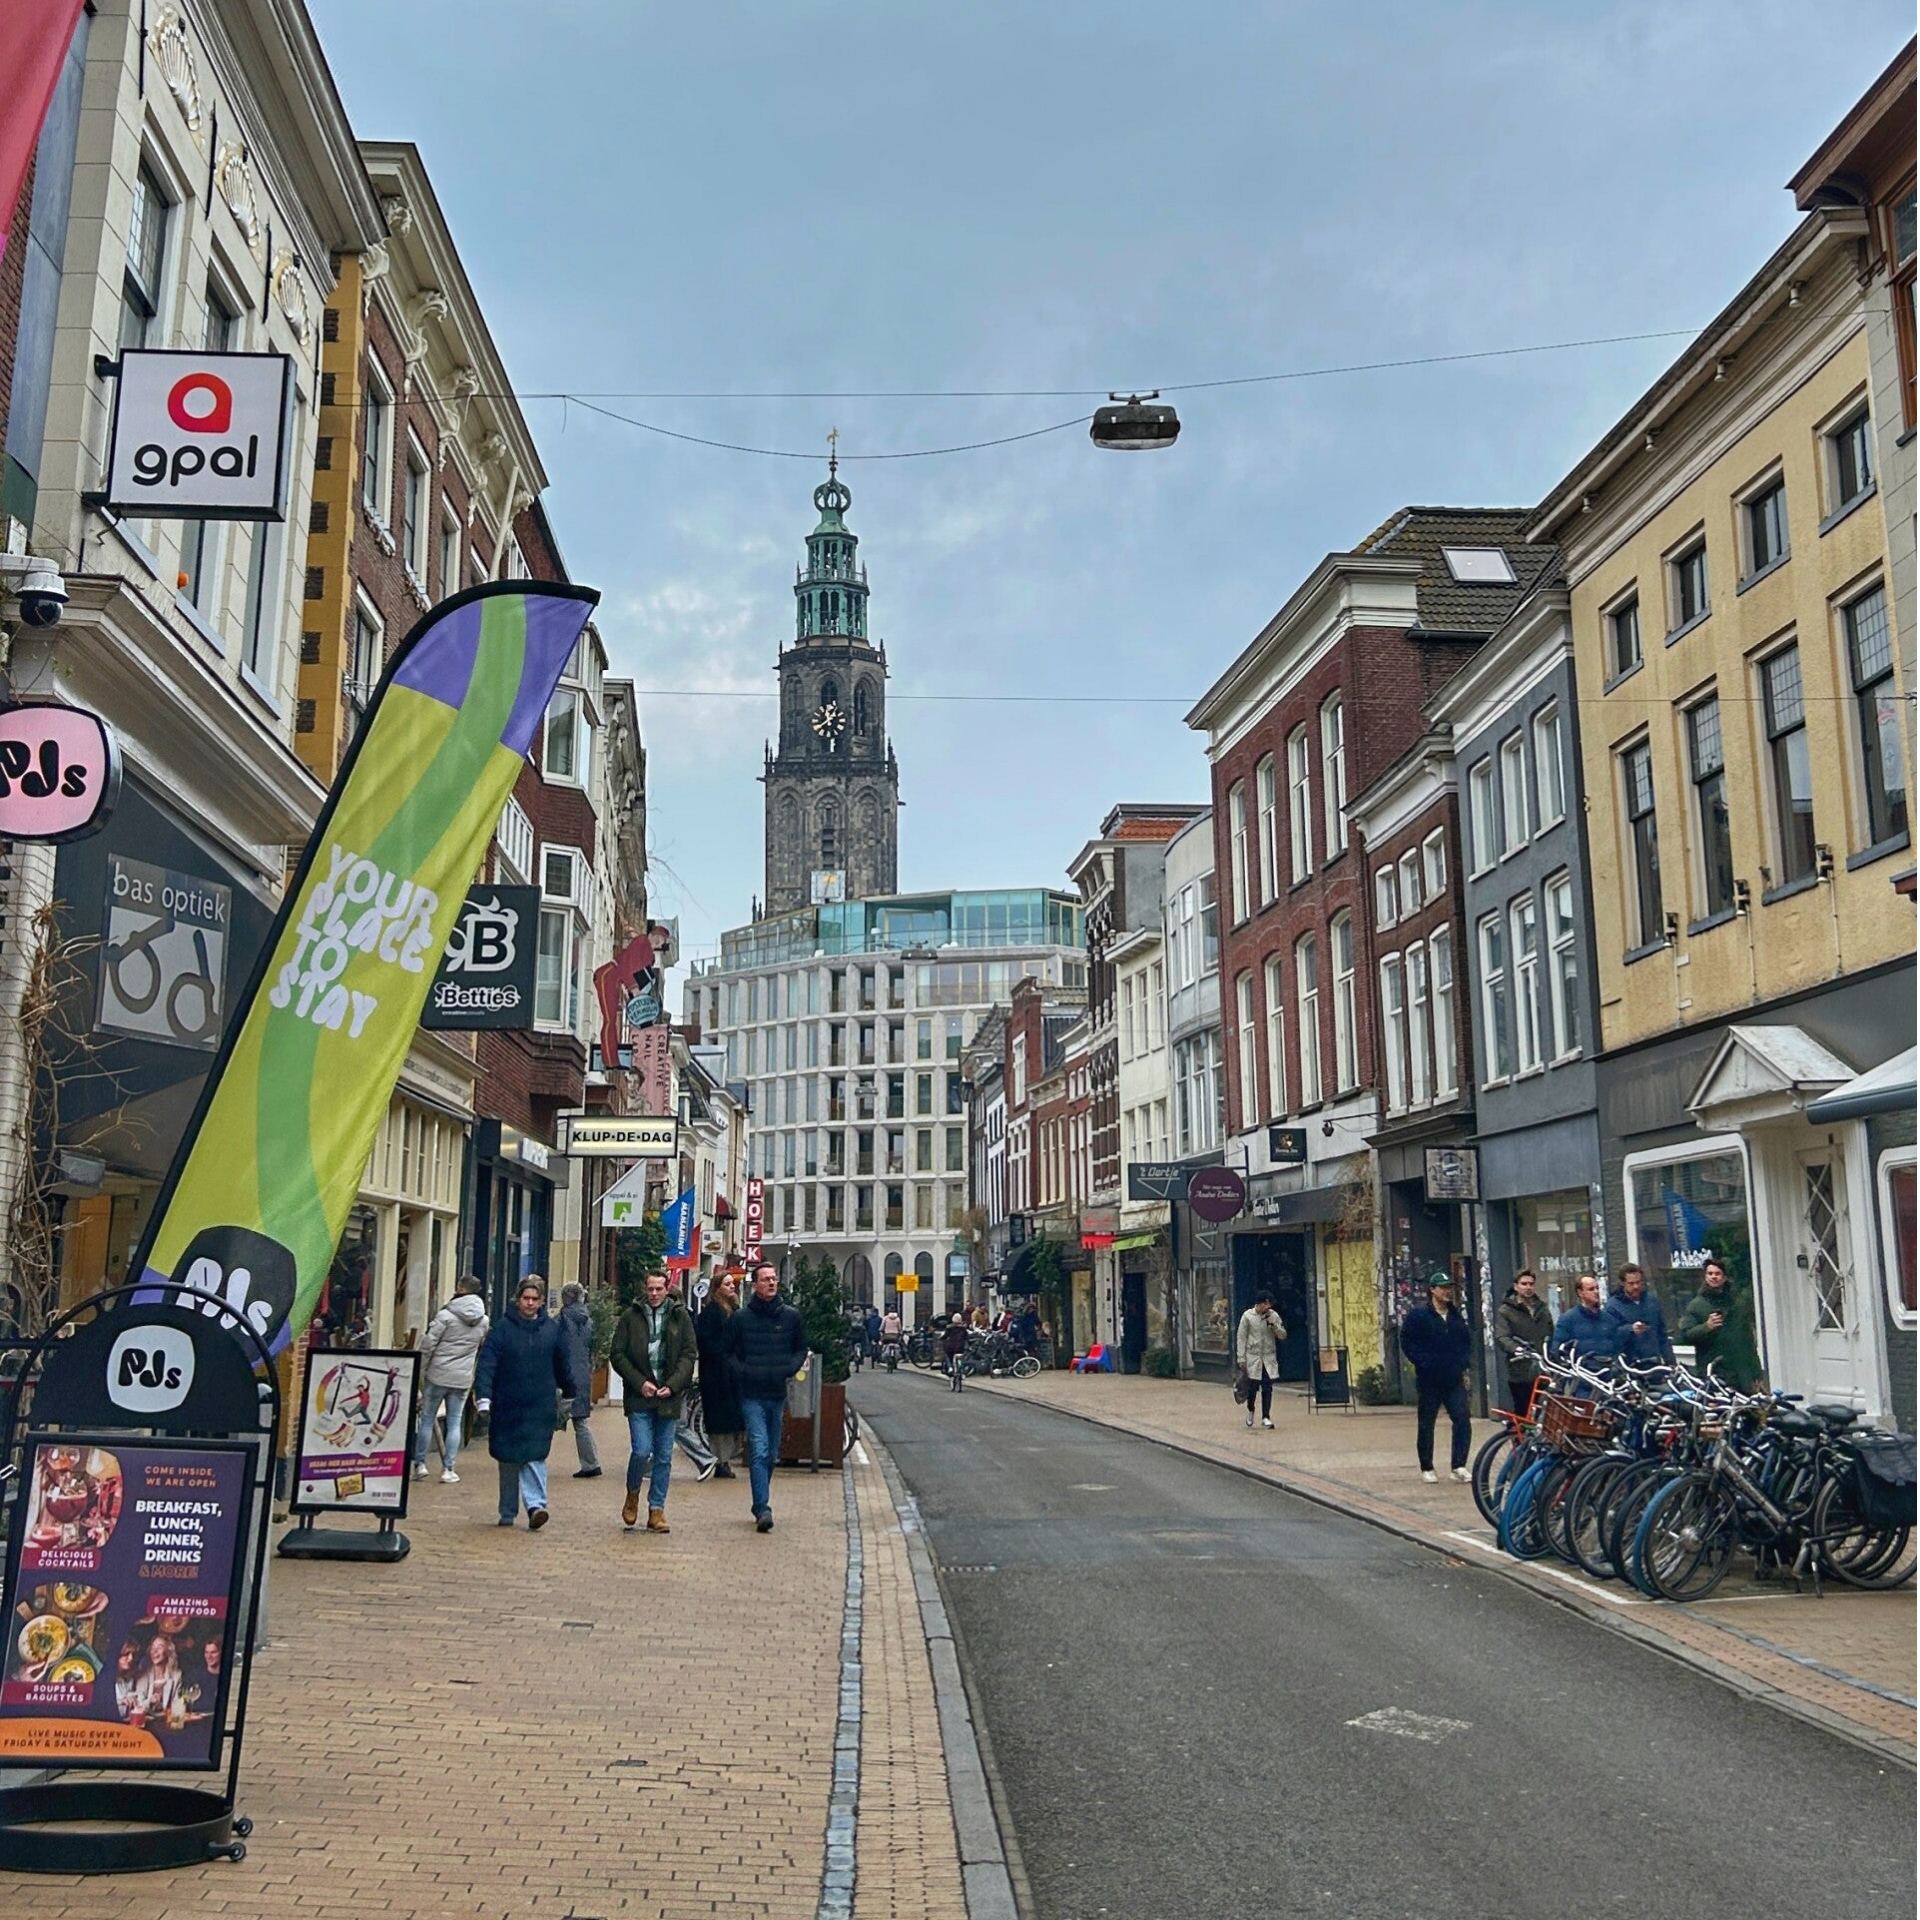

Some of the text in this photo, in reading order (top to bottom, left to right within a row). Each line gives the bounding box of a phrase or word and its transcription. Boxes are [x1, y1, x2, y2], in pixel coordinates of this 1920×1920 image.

[133, 434, 258, 487] gpal
[113, 863, 225, 924] bas optiek
[325, 843, 438, 940] YOUR
[302, 882, 433, 973] PLACE
[296, 921, 348, 981] TO
[269, 963, 378, 1039] STAY
[440, 986, 517, 1007] Betties
[644, 1034, 652, 1060] NAIL
[656, 1034, 665, 1087] CREATIVE
[747, 1181, 762, 1260] HOEK
[118, 1349, 182, 1389] PJs
[145, 1466, 216, 1478] COME INSIDE,
[146, 1478, 216, 1488] WE ARE OPEN
[136, 1500, 222, 1517] BREAKFAST,
[150, 1517, 204, 1533] LUNCH,
[144, 1533, 204, 1548] DINNER,
[41, 1551, 93, 1559] DELICIOUS
[145, 1550, 202, 1563] DRINKS
[38, 1559, 94, 1568] COCKTAILS
[139, 1566, 149, 1577] &
[164, 1598, 208, 1606] AMAZING
[154, 1606, 216, 1615] STREETFOOD
[33, 1685, 67, 1693] SOUPS
[25, 1693, 84, 1702] BAGUETTES
[28, 1730, 50, 1738] LIVE
[89, 1731, 121, 1739] EVERY
[4, 1739, 41, 1747] FRIDAY
[54, 1740, 108, 1748] SATURDAY
[112, 1741, 143, 1749] NIGHT
